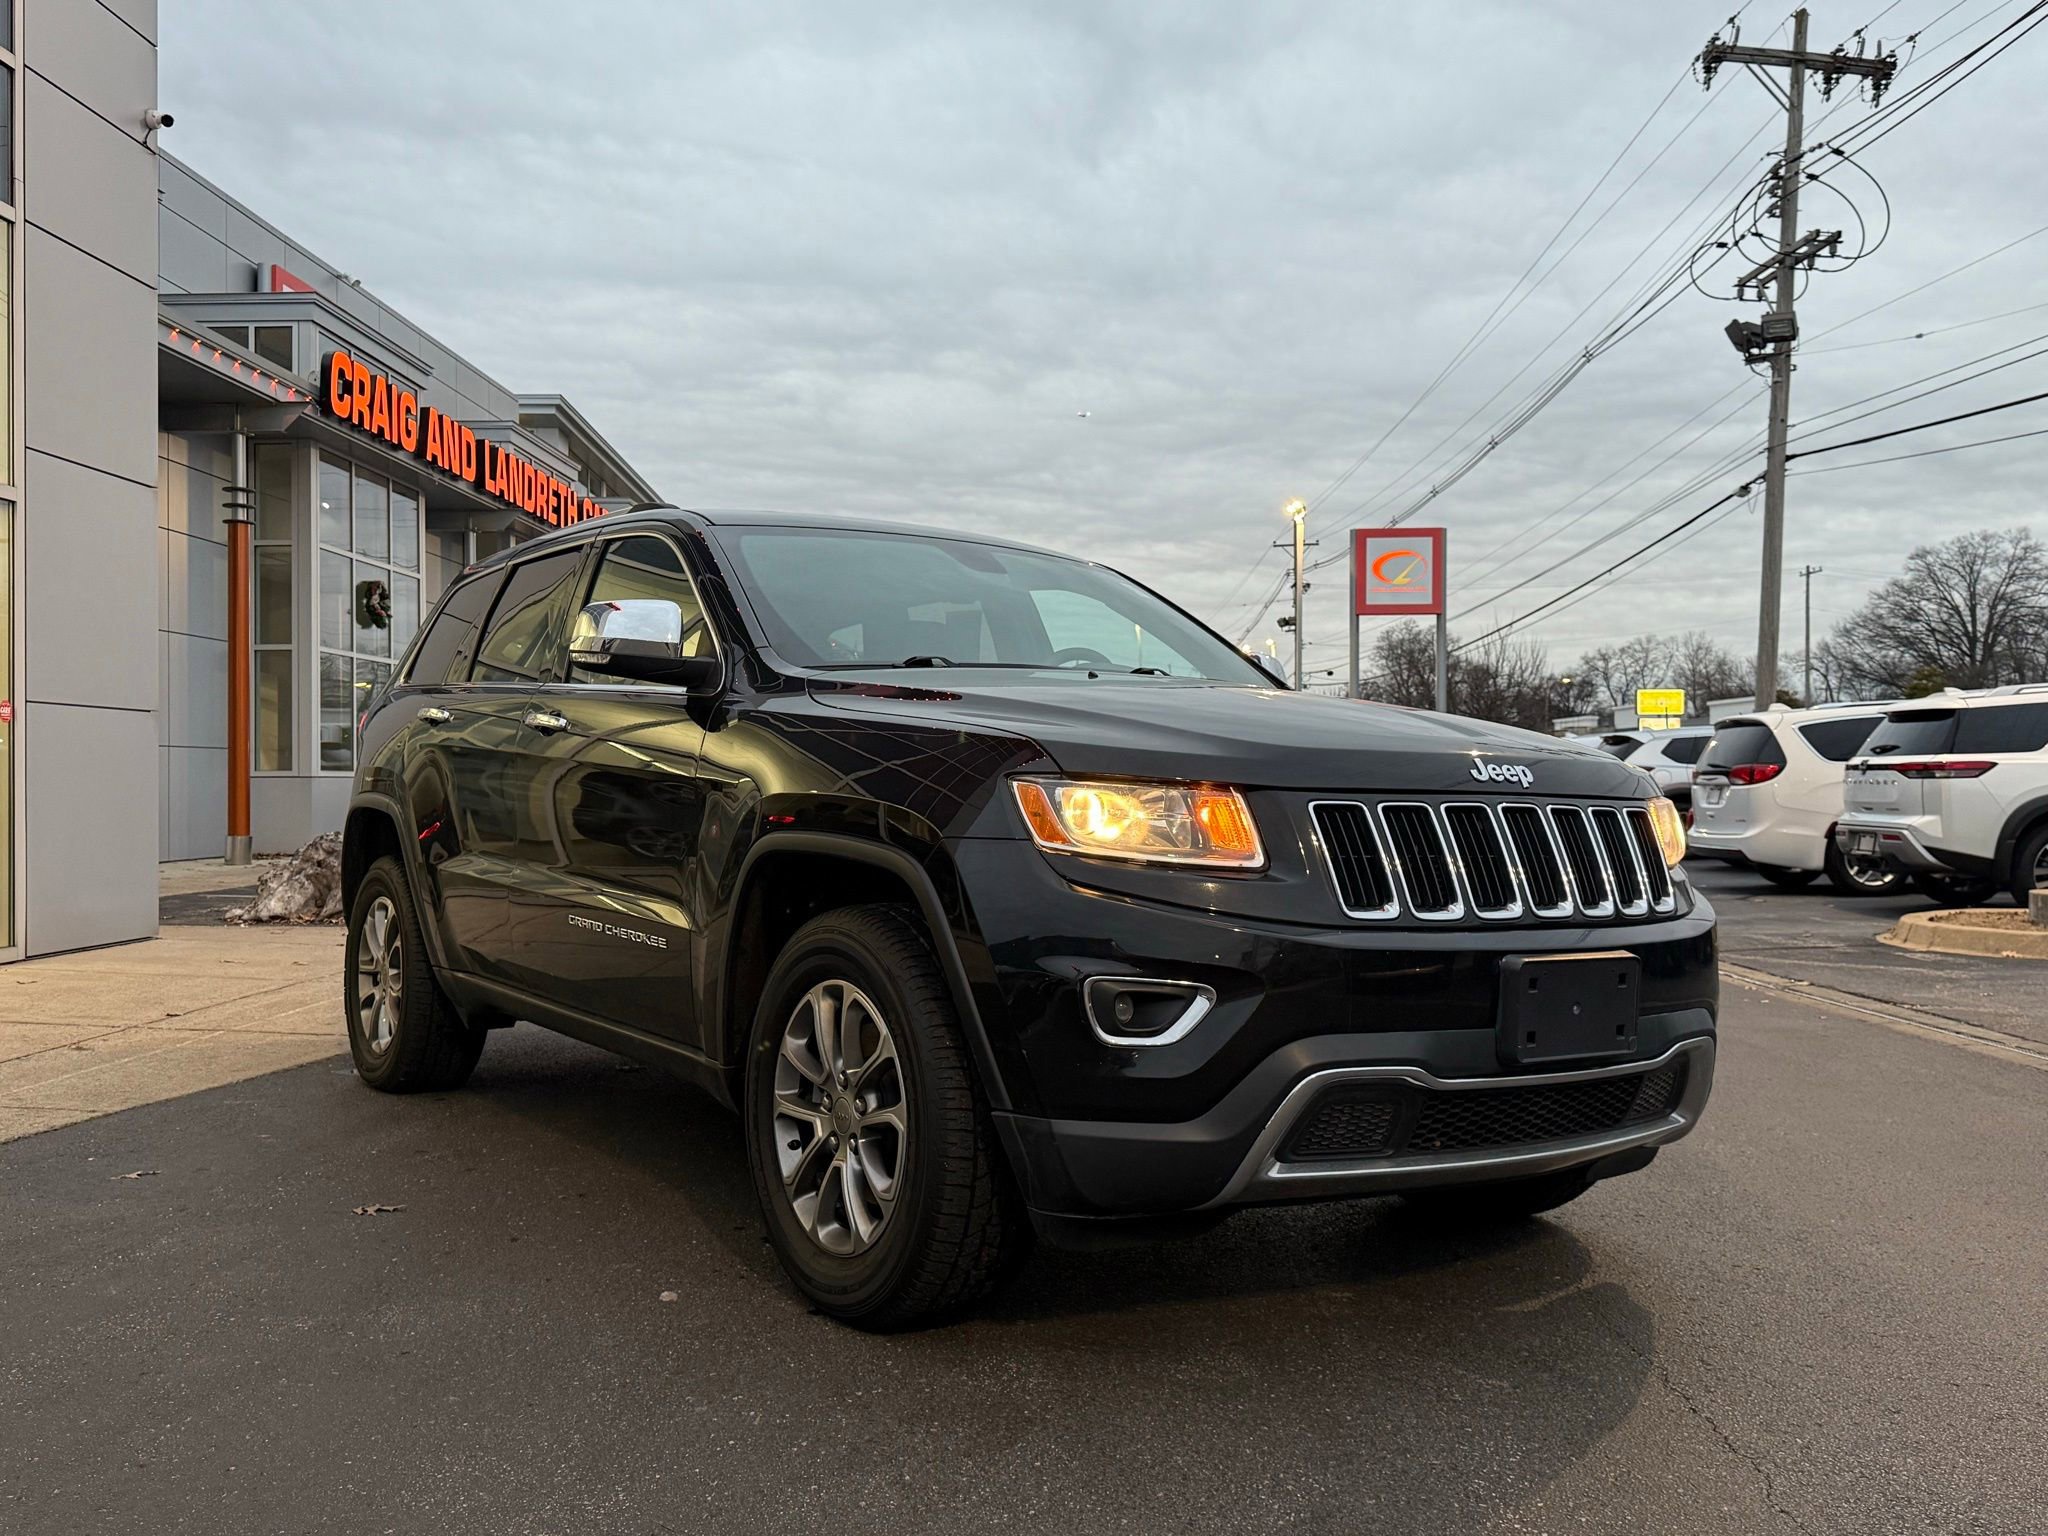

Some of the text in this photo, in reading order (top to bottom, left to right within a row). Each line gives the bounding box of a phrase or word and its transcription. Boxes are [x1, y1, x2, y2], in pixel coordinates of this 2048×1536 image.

[331, 351, 579, 528] CRAIG AND LANDRETH
[1469, 757, 1534, 789] Jeep
[568, 914, 667, 948] GRAND CHEROKEE
